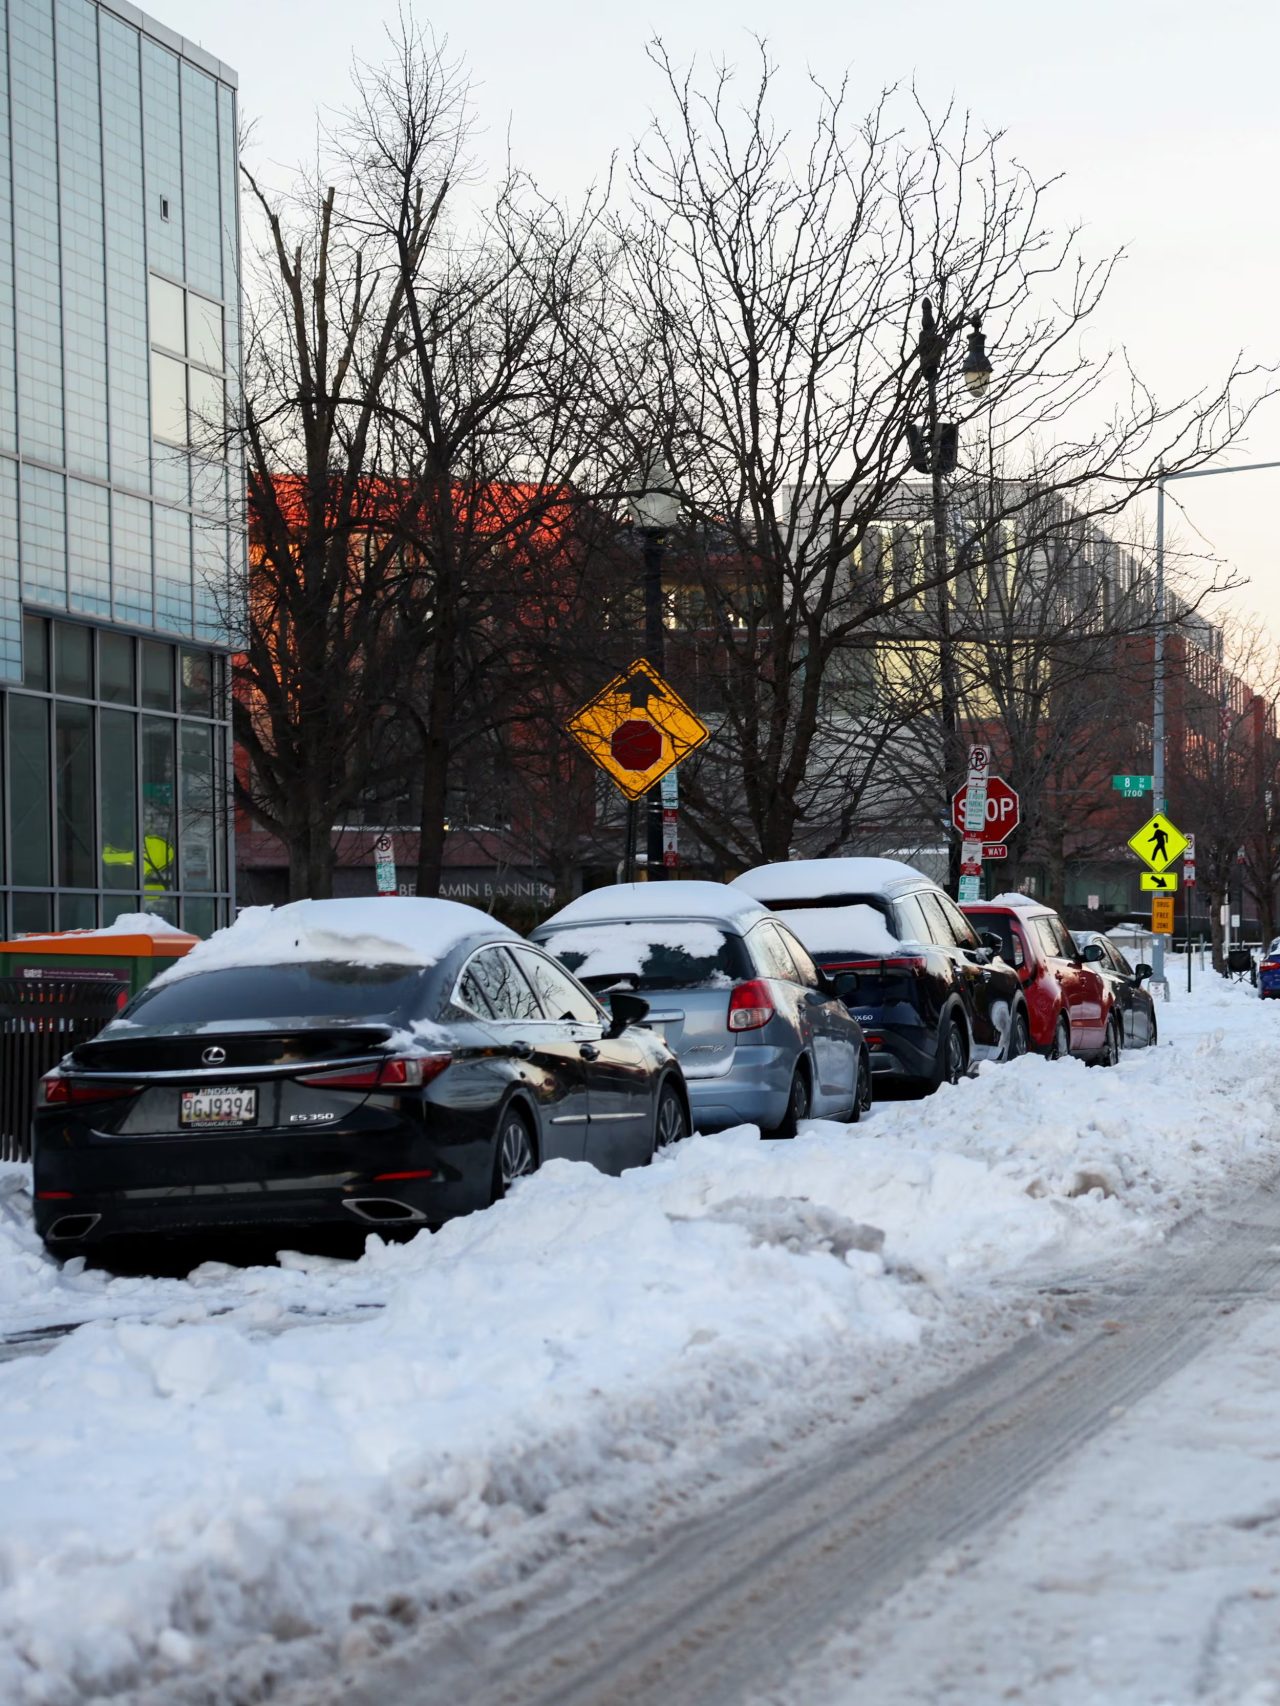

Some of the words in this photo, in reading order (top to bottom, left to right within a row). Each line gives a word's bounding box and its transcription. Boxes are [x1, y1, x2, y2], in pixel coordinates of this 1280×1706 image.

[1124, 777, 1131, 788] 8
[1124, 789, 1143, 798] 1700
[957, 797, 1014, 823] SOP
[988, 847, 1003, 856] WAY
[401, 884, 479, 897] BEAMIN
[485, 882, 549, 897] BANNEK
[183, 1096, 253, 1119] 9GJ9394
[310, 1113, 334, 1121] 350
